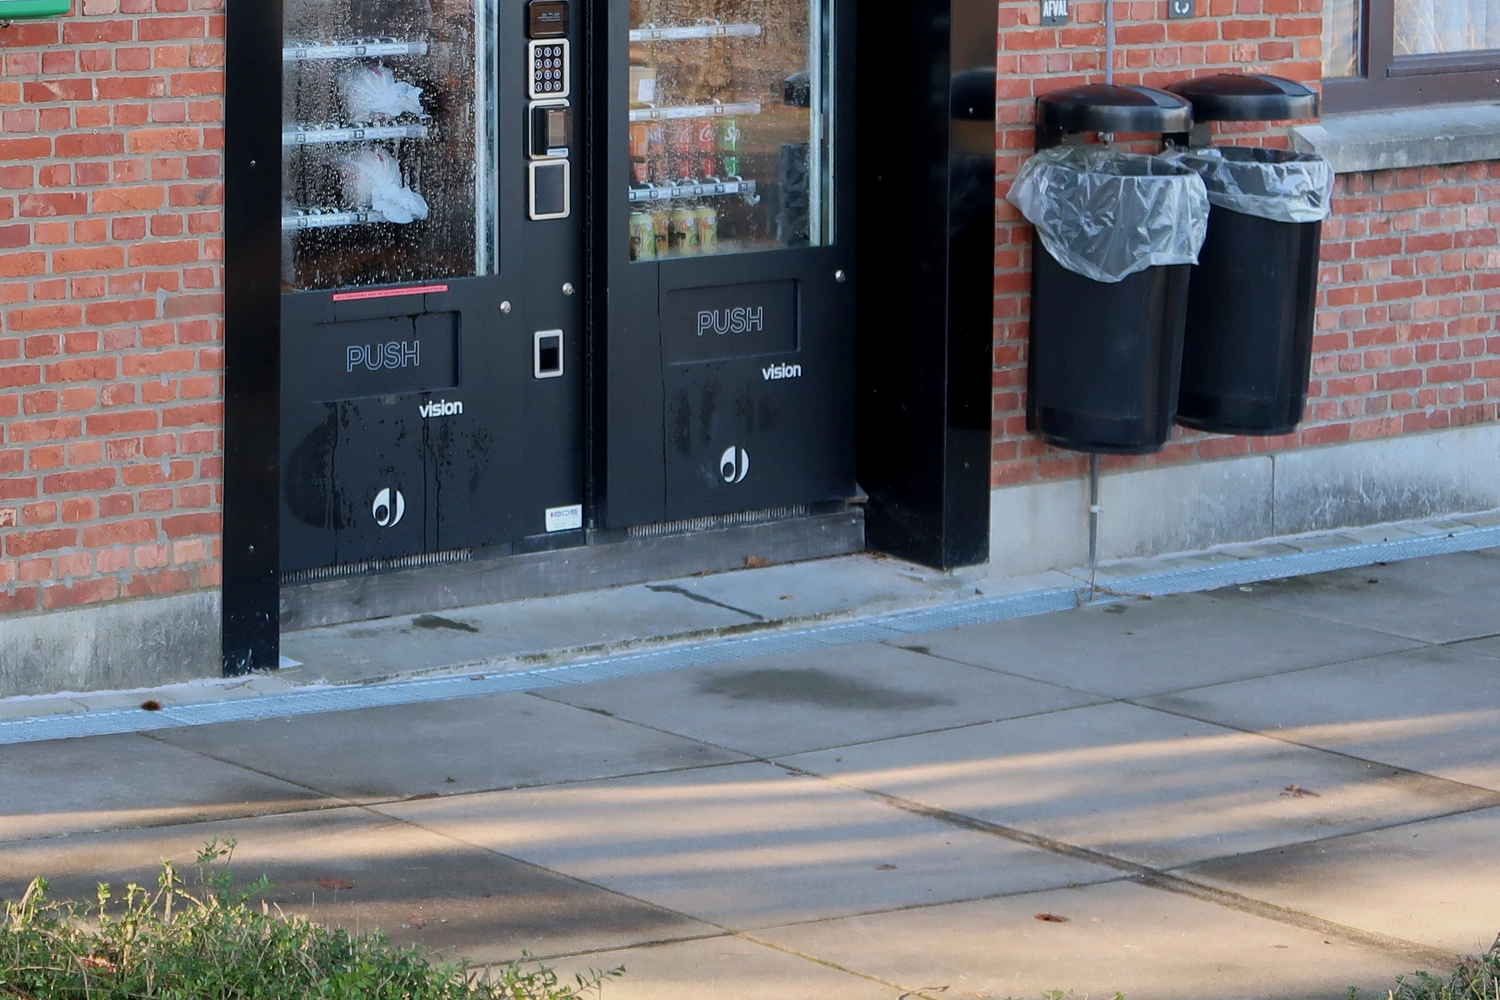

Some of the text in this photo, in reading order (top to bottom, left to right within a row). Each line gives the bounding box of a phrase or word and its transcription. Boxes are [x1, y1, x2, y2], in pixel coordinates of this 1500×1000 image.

[1043, 0, 1068, 17] AFVAL
[697, 306, 763, 336] PUSH
[346, 340, 420, 373] PUSH
[762, 362, 802, 381] vision
[419, 399, 463, 418] vision
